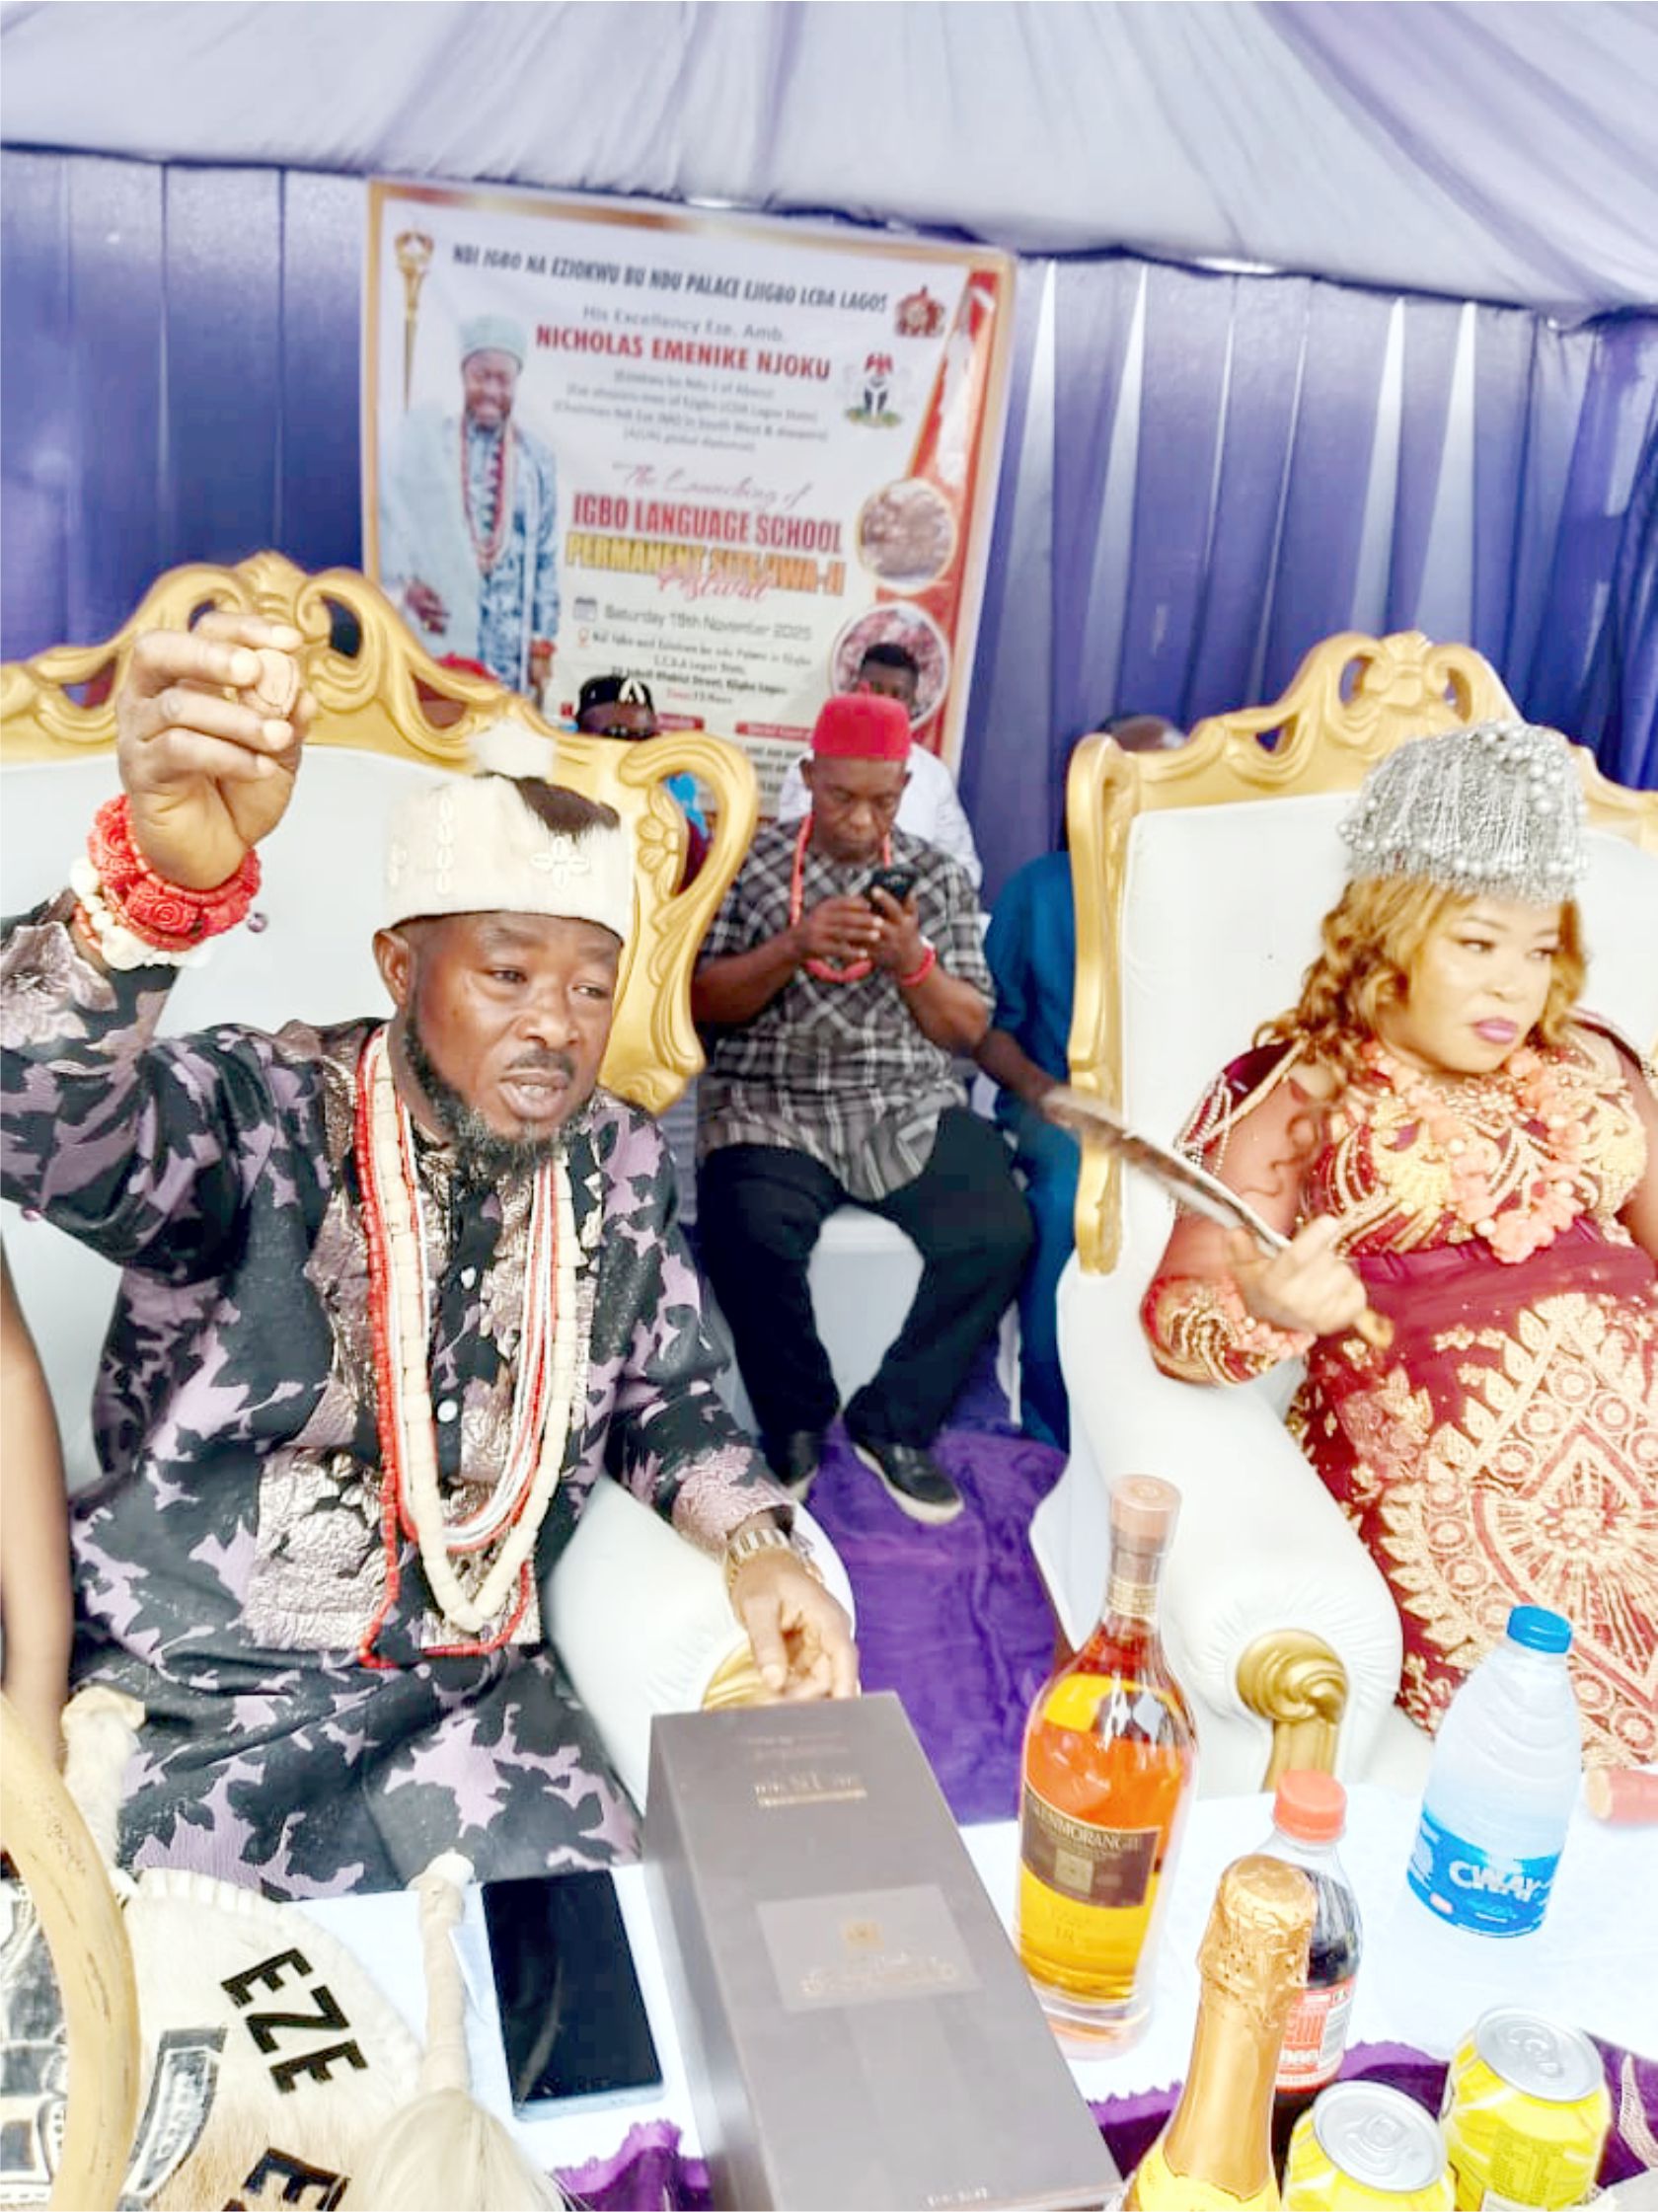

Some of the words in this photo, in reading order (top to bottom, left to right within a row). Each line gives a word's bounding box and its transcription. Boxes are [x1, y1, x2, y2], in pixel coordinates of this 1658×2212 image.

[453, 244, 480, 267] NDI
[483, 248, 522, 270] IGBO
[525, 254, 547, 277] NA
[551, 257, 621, 284] EZIOKWU
[624, 265, 646, 287] BU
[649, 268, 682, 291] NDU
[686, 273, 741, 299] PALACE
[744, 280, 796, 306] EJIGBO
[799, 286, 835, 309] LCDA
[840, 290, 888, 314] LAGOS
[583, 305, 608, 322] His
[614, 307, 700, 336] Excellency
[535, 324, 643, 359] NICHOLAS
[650, 338, 748, 372] EMENIKE
[757, 349, 831, 382] NJOKU
[572, 493, 630, 530] IGBO
[633, 501, 750, 544] LANGUAGE
[753, 512, 843, 555] SCHOOL
[605, 603, 665, 629] Saturday
[703, 614, 772, 637] November
[1448, 1859, 1542, 1903] CWAY
[220, 1947, 370, 2096] EZE
